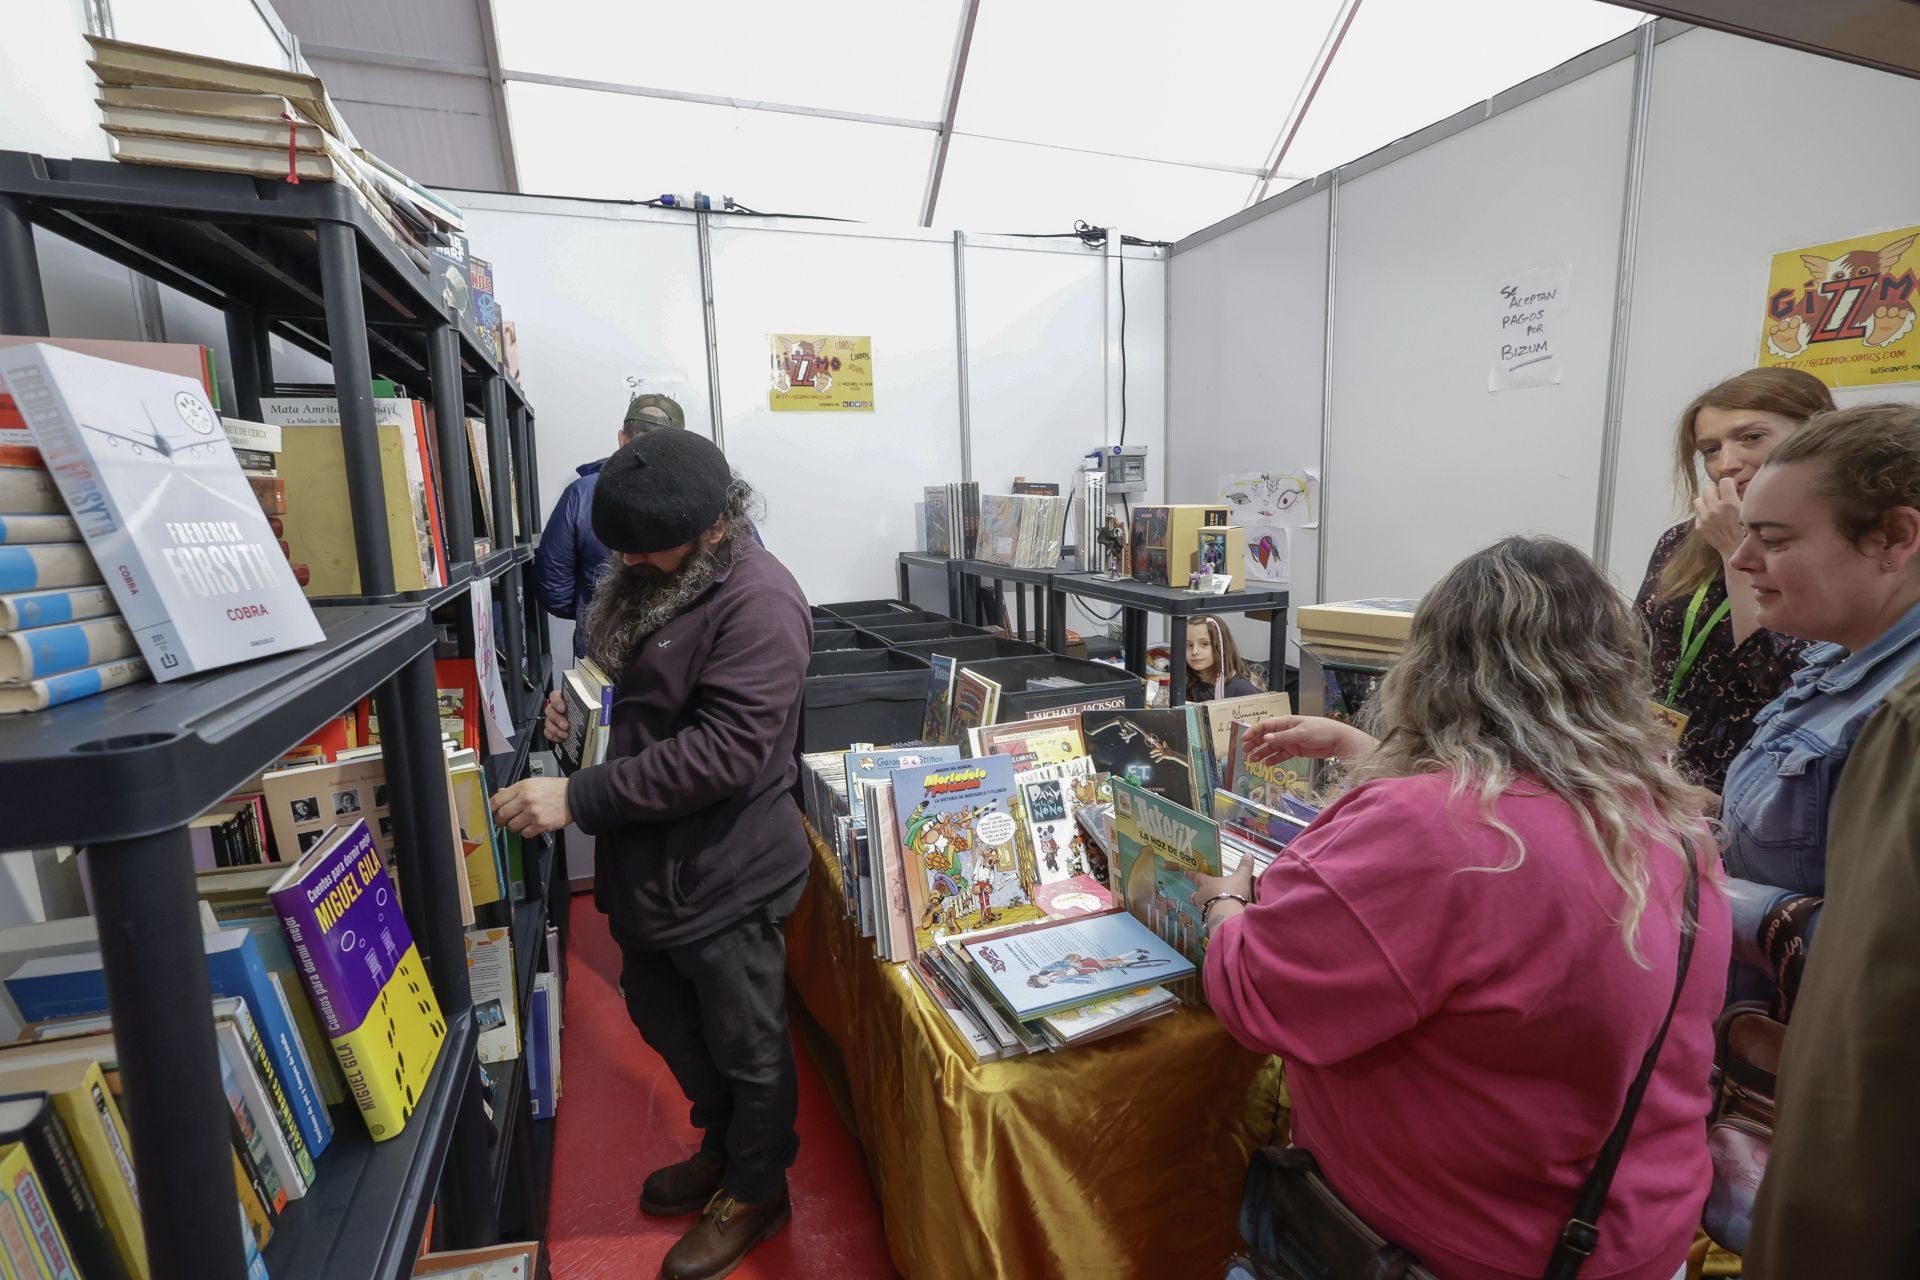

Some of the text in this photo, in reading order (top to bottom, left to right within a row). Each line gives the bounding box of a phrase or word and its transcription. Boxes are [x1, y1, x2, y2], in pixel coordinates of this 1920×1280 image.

[1509, 288, 1557, 309] ACEPTAN
[1768, 267, 1920, 345] GIZZM
[1502, 309, 1545, 329] PAGOS
[1526, 324, 1544, 336] POR
[1501, 340, 1548, 360] BIZUM
[270, 404, 299, 415] Mata
[166, 521, 244, 545] FREDERICK
[118, 565, 140, 596] COBRA
[161, 543, 282, 599] FORSYTH
[226, 604, 270, 622] COBRA
[1033, 698, 1126, 720] MICHAEL JACKSON
[1027, 784, 1062, 803] DANY
[1139, 830, 1150, 842] LA
[1150, 835, 1167, 851] HOZ
[1167, 843, 1179, 856] DE
[1179, 850, 1197, 867] ORO
[306, 832, 372, 904] Cuentos para dormir mejor
[314, 847, 382, 935] MIGUEL GILA
[283, 916, 340, 1031] Cuentos para dormir mejor
[336, 1042, 376, 1111] MIGUEL GILA
